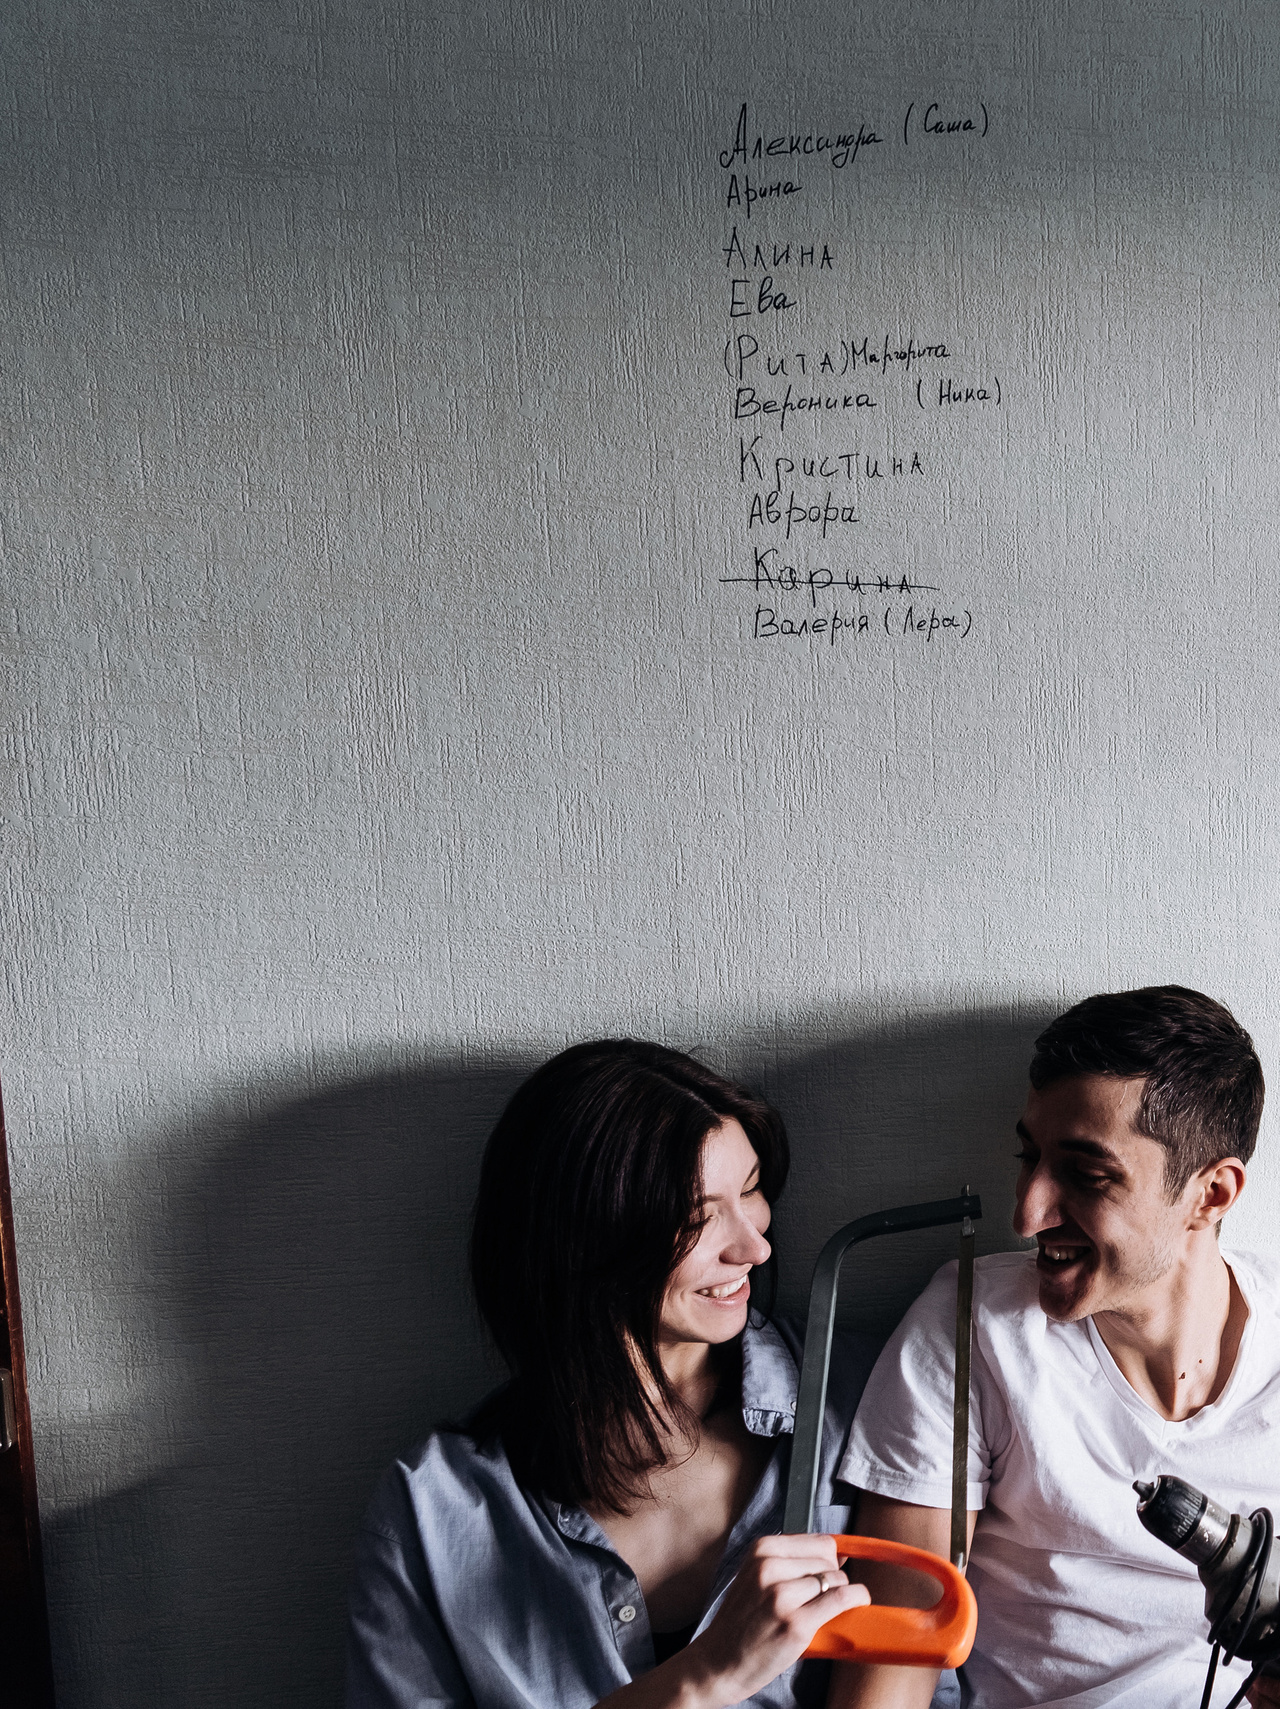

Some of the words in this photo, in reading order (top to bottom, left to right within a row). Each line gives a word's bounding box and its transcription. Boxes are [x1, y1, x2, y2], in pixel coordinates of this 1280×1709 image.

[719, 102, 884, 168] Александра
[903, 102, 989, 145] (Саша)
[727, 174, 803, 219] Арина
[729, 276, 798, 318] Ева
[734, 384, 878, 431] Вероника
[916, 376, 1001, 409] (Ника)
[749, 491, 860, 539] Аврора
[753, 604, 870, 646] Валерия
[884, 606, 972, 642] (Лера)
